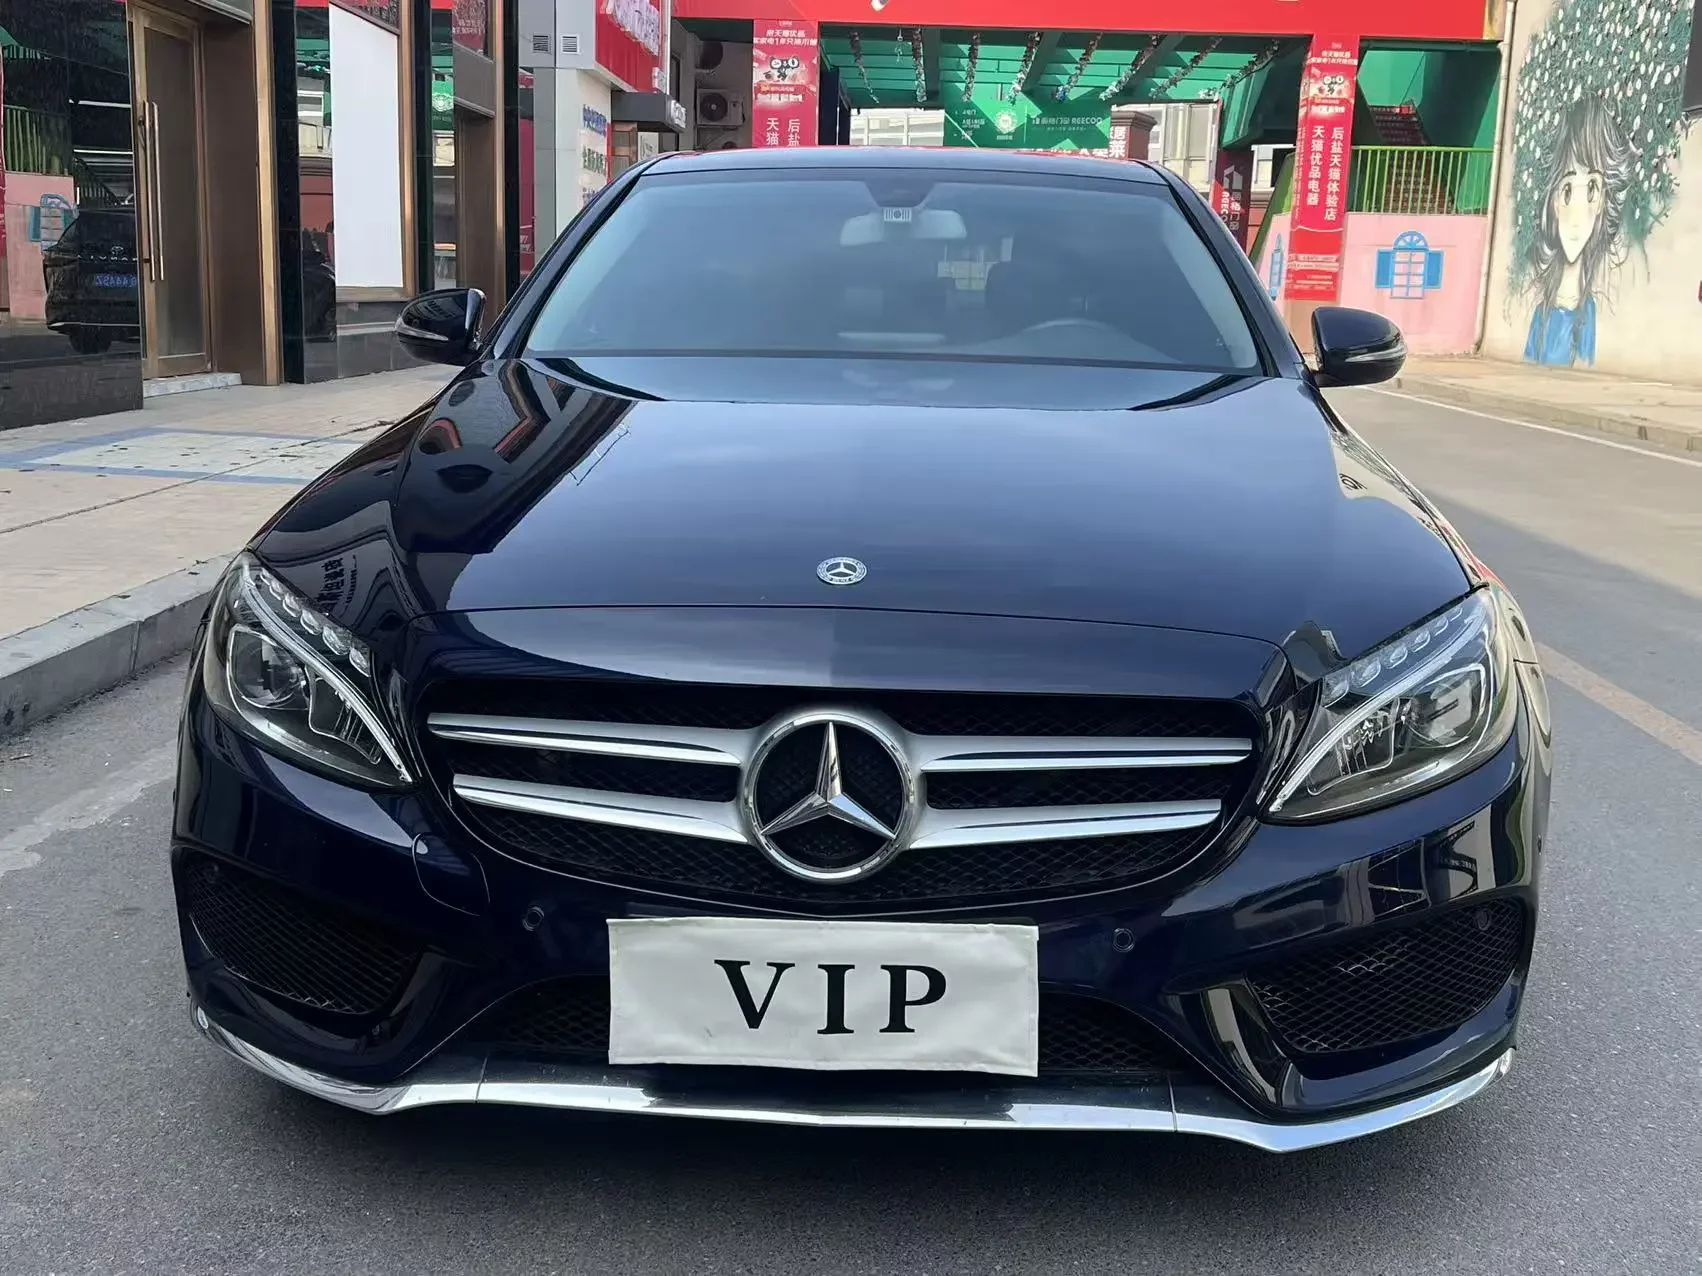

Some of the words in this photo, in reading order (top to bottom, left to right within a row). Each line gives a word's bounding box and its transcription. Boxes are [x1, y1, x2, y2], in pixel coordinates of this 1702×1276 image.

[766, 117, 779, 146] 天猫
[1307, 126, 1325, 206] 天猫优品电器
[714, 959, 947, 1035] VIP
